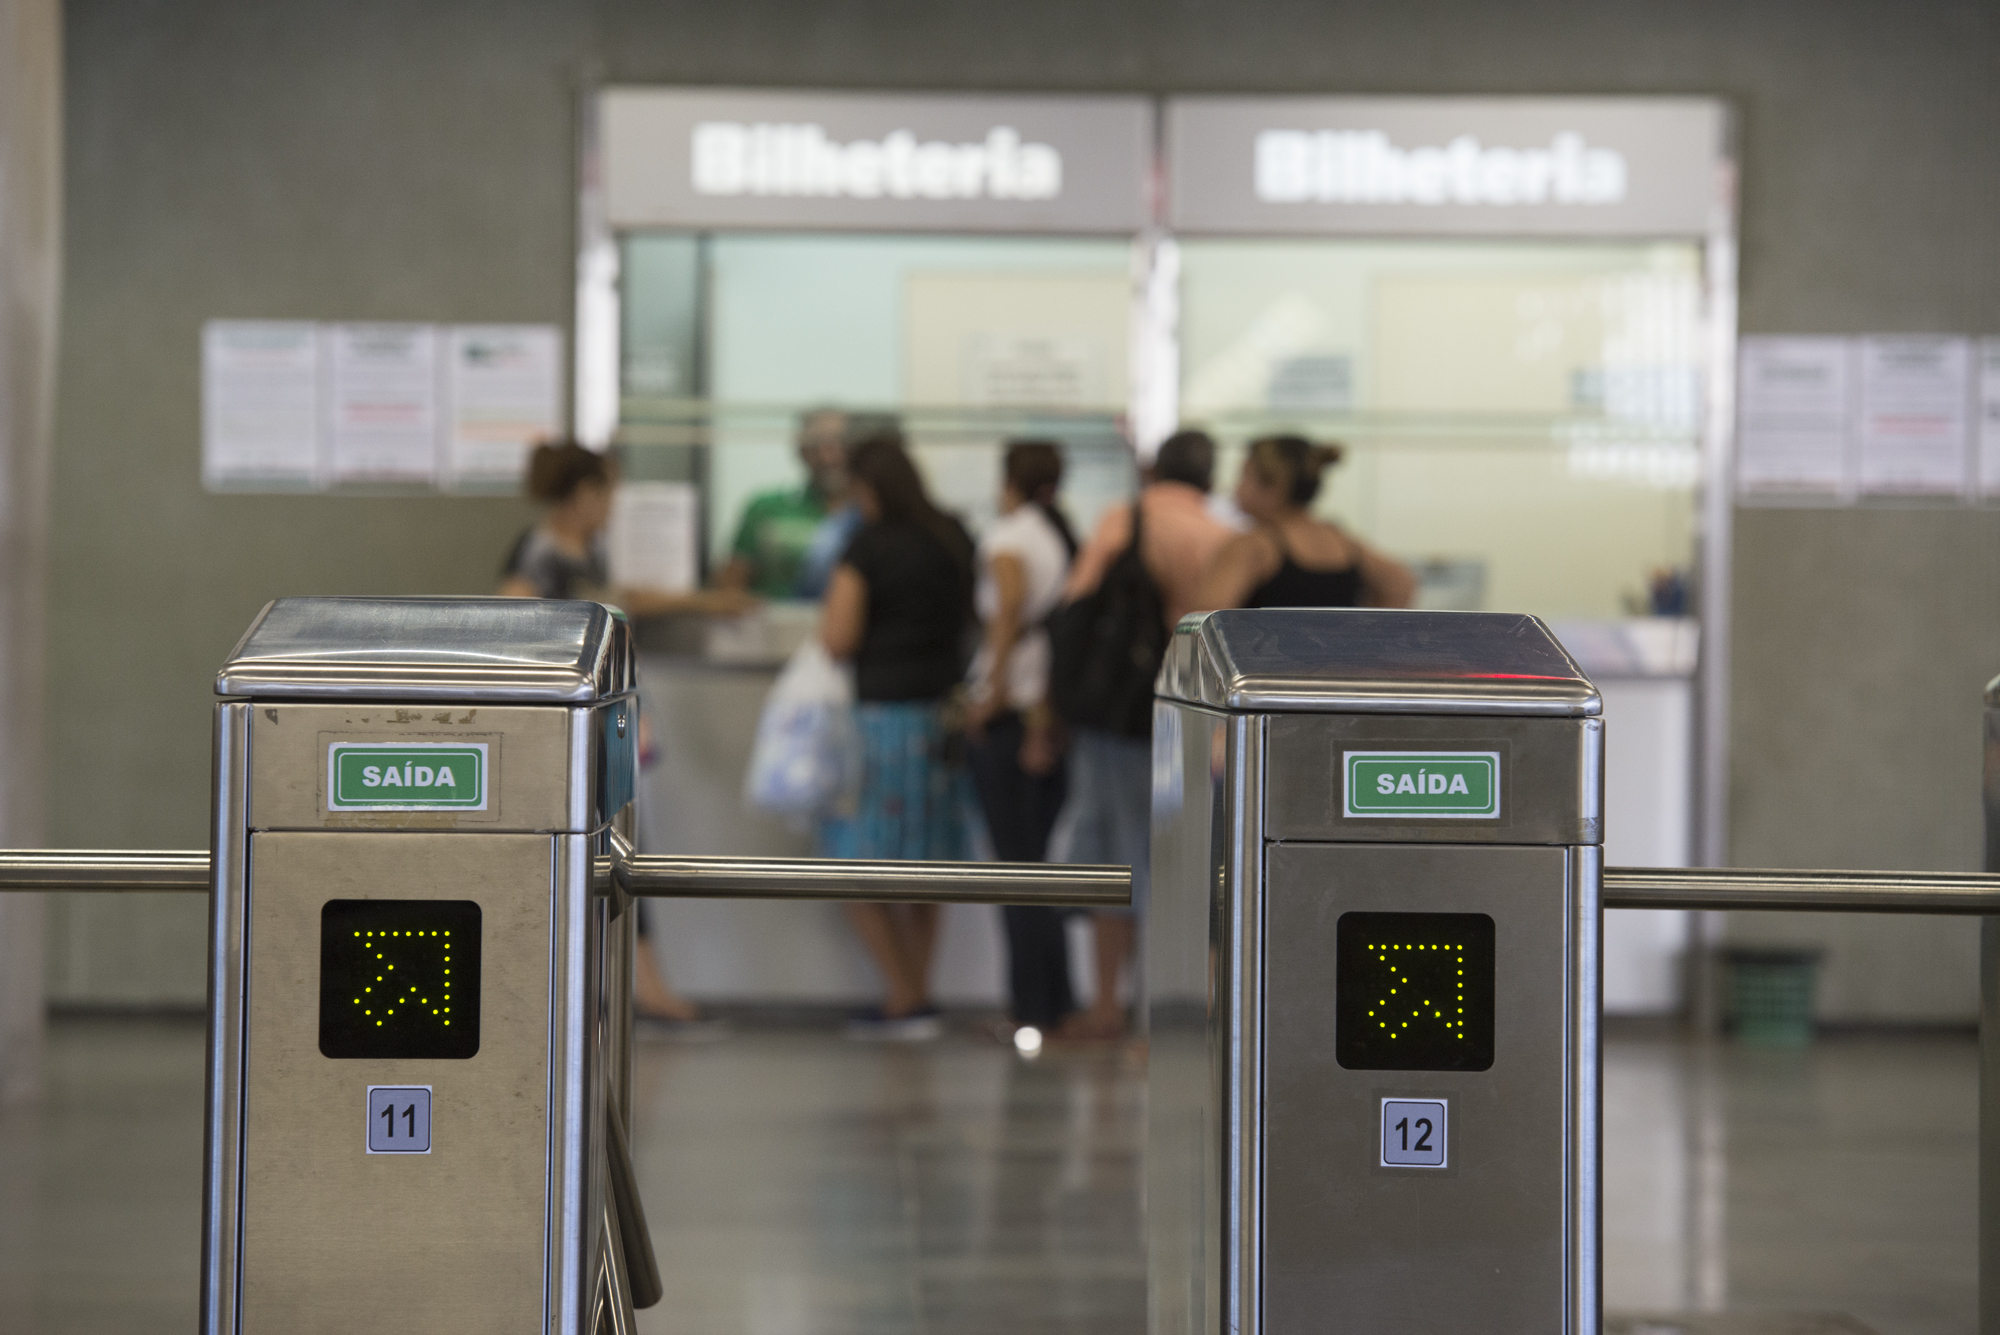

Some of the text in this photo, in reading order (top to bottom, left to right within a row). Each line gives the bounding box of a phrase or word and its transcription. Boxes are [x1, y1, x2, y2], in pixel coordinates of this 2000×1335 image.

[691, 123, 1062, 200] Bilheteria
[1255, 131, 1627, 205] Bilheteria
[362, 760, 456, 787] SAÍDA
[1376, 768, 1469, 795] SAÍDA
[380, 1103, 416, 1138] 11
[1394, 1117, 1433, 1152] 12
